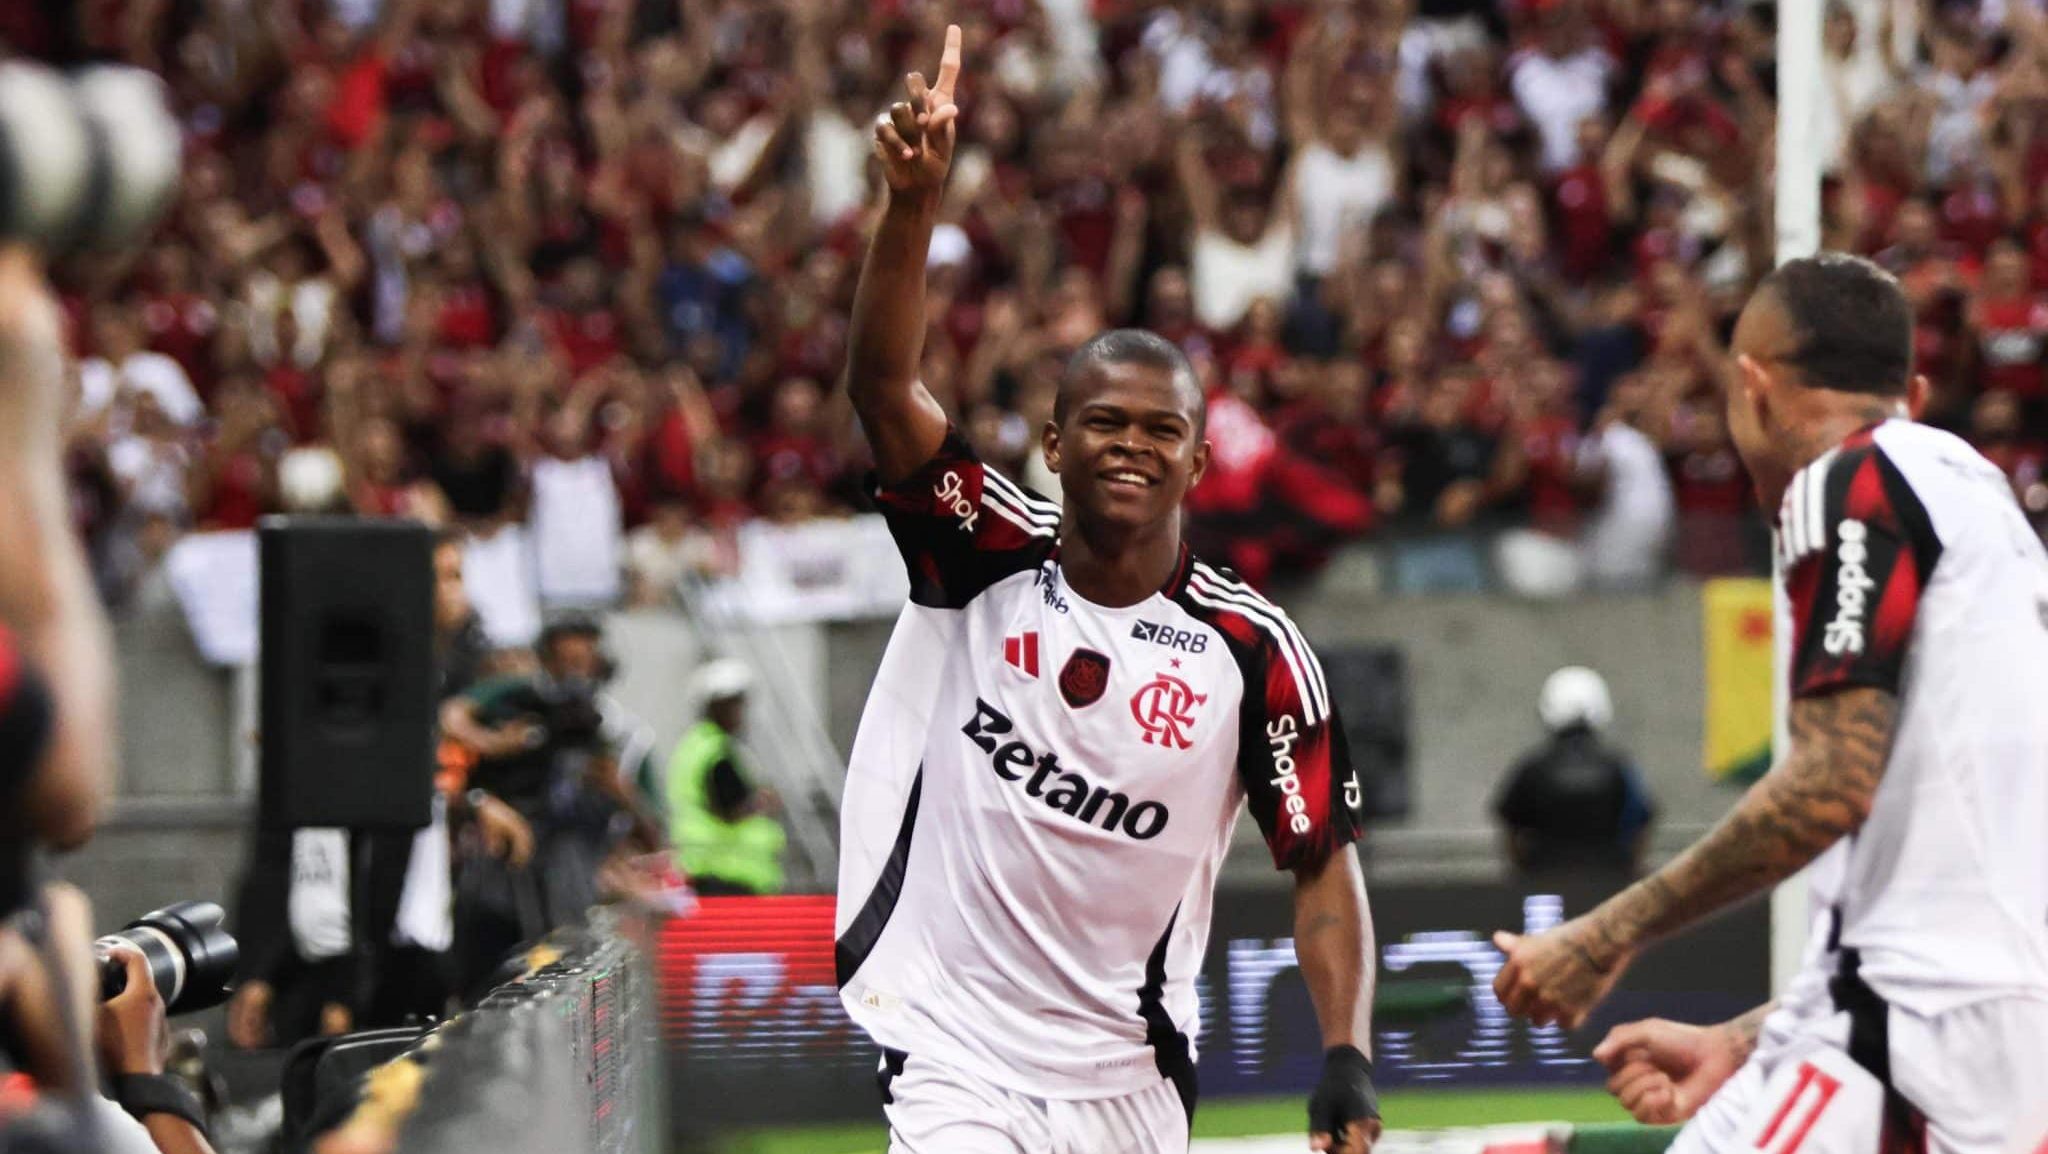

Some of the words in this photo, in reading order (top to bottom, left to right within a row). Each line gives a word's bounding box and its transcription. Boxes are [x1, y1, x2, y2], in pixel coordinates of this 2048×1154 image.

[1156, 625, 1208, 653] BRB
[1824, 518, 1874, 655] Shopee
[961, 696, 1169, 840] Betano
[1266, 714, 1311, 834] Shopee
[1753, 1060, 1843, 1154] 11
